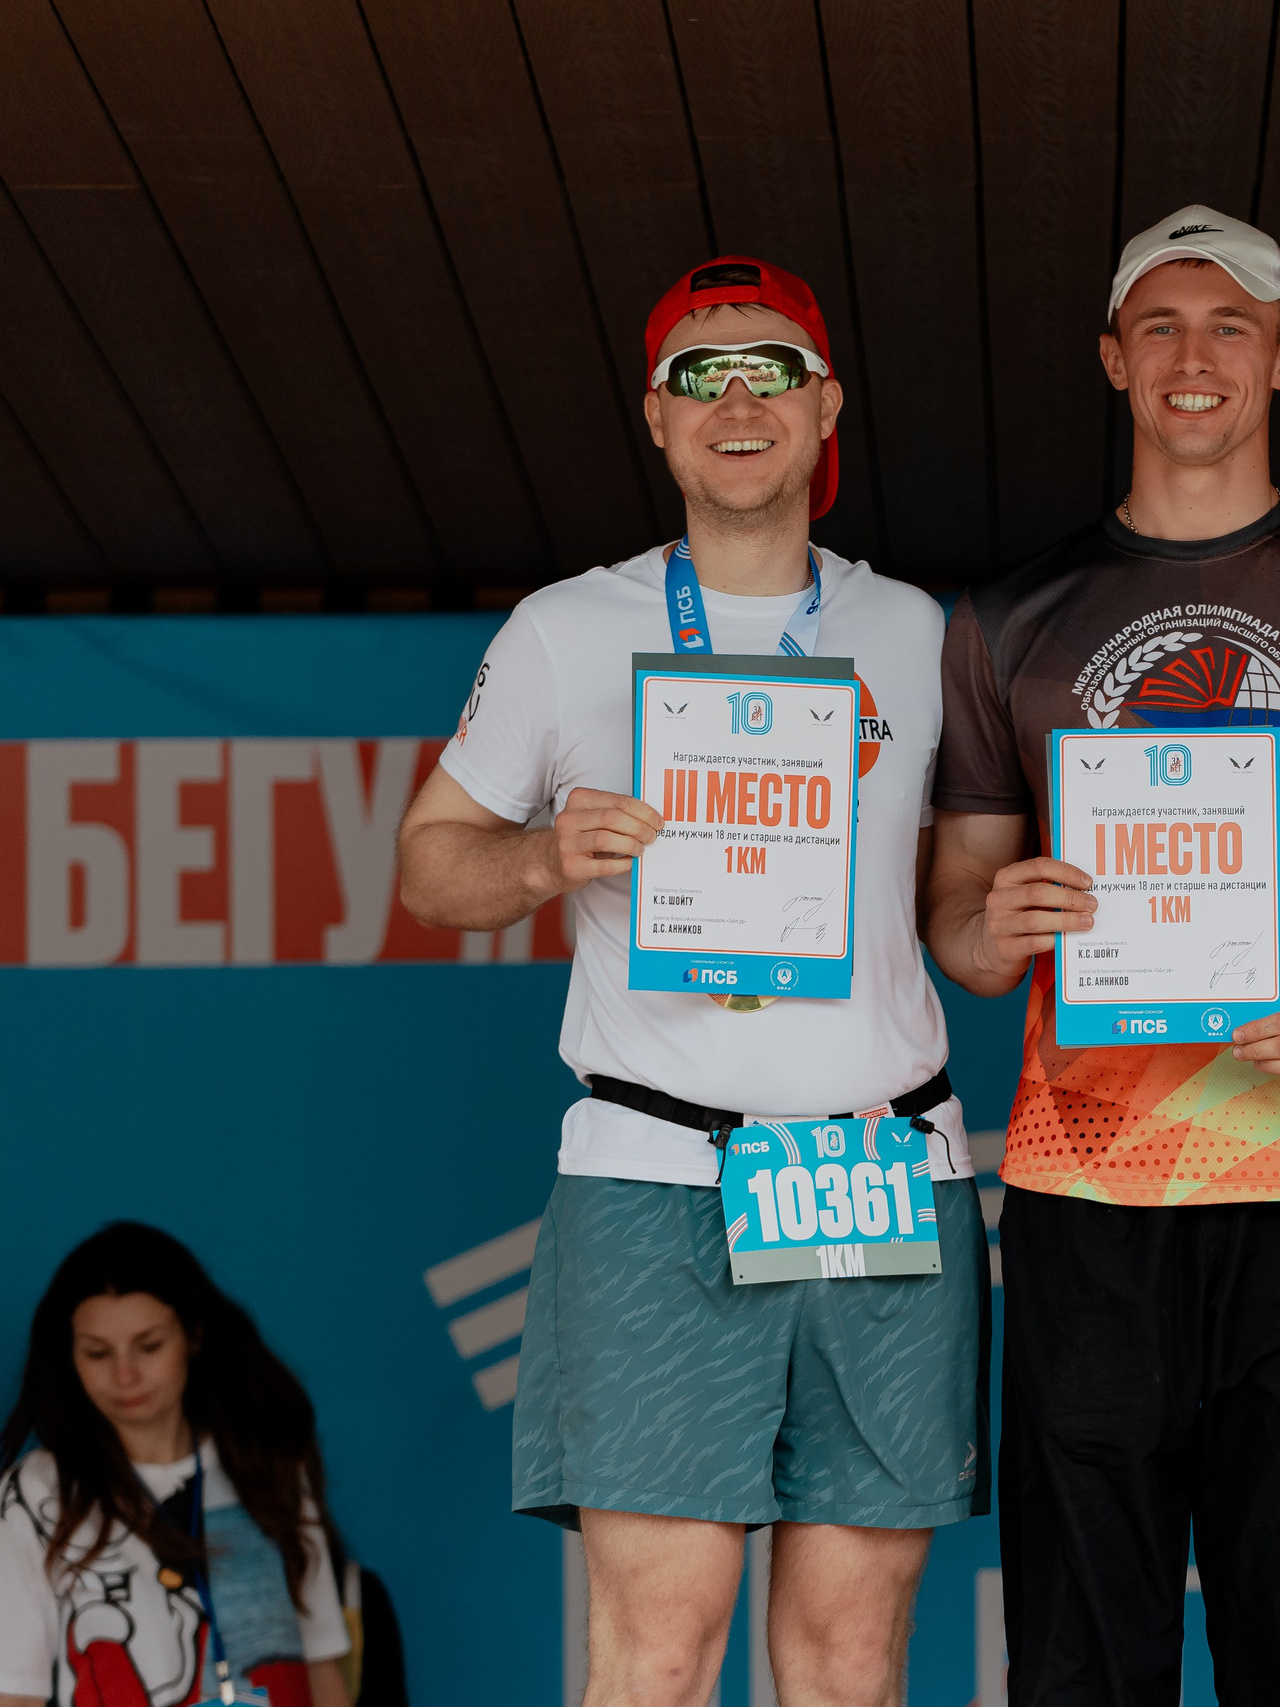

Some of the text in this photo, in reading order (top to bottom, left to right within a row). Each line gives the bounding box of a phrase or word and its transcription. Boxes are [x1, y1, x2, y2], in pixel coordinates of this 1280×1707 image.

[676, 585, 696, 624] ПСБ
[806, 593, 820, 615] СБ
[1071, 605, 1182, 695] МЕЖДУНАРОДНАЯ
[1185, 604, 1280, 641] ОЛИМПИАДА
[1080, 631, 1147, 710] ОБРАЗОВАТЕЛЬНЫХ
[1146, 618, 1222, 635] ОРГАНИЗАЦИЙ
[1222, 621, 1269, 649] ВЫСШЕГО
[726, 691, 773, 736] 10
[859, 718, 894, 742] TRA
[673, 752, 823, 769] Награждается участник, занявший
[1143, 743, 1192, 787] 10
[663, 769, 831, 829] III МЕСТО
[1092, 805, 1245, 817] Награждается участник, занявший
[656, 829, 840, 846] реди мужчин 18 лет и старше на дистанции
[1095, 822, 1243, 876] I МЕСТО
[725, 846, 766, 874] 1 КМ
[1101, 883, 1135, 893] мужчин
[1138, 881, 1148, 891] 18
[1150, 882, 1164, 891] лет
[1166, 882, 1172, 890] и
[1174, 881, 1206, 892] старше
[1207, 881, 1218, 890] на
[1219, 880, 1267, 891] дистанции
[653, 895, 693, 906] К.С. ШОЙГУ
[1148, 895, 1191, 923] 1 КМ
[653, 923, 702, 934] Д.С. АННИКОВ
[1078, 947, 1119, 959] К.С. ШОЙГУ
[701, 969, 738, 985] ПСБ
[1079, 976, 1129, 987] Д.С. АННИКОВ
[1130, 1019, 1168, 1034] ПСБ
[741, 1141, 770, 1155] ПСБ
[811, 1125, 846, 1158] 10
[747, 1161, 915, 1243] 10361
